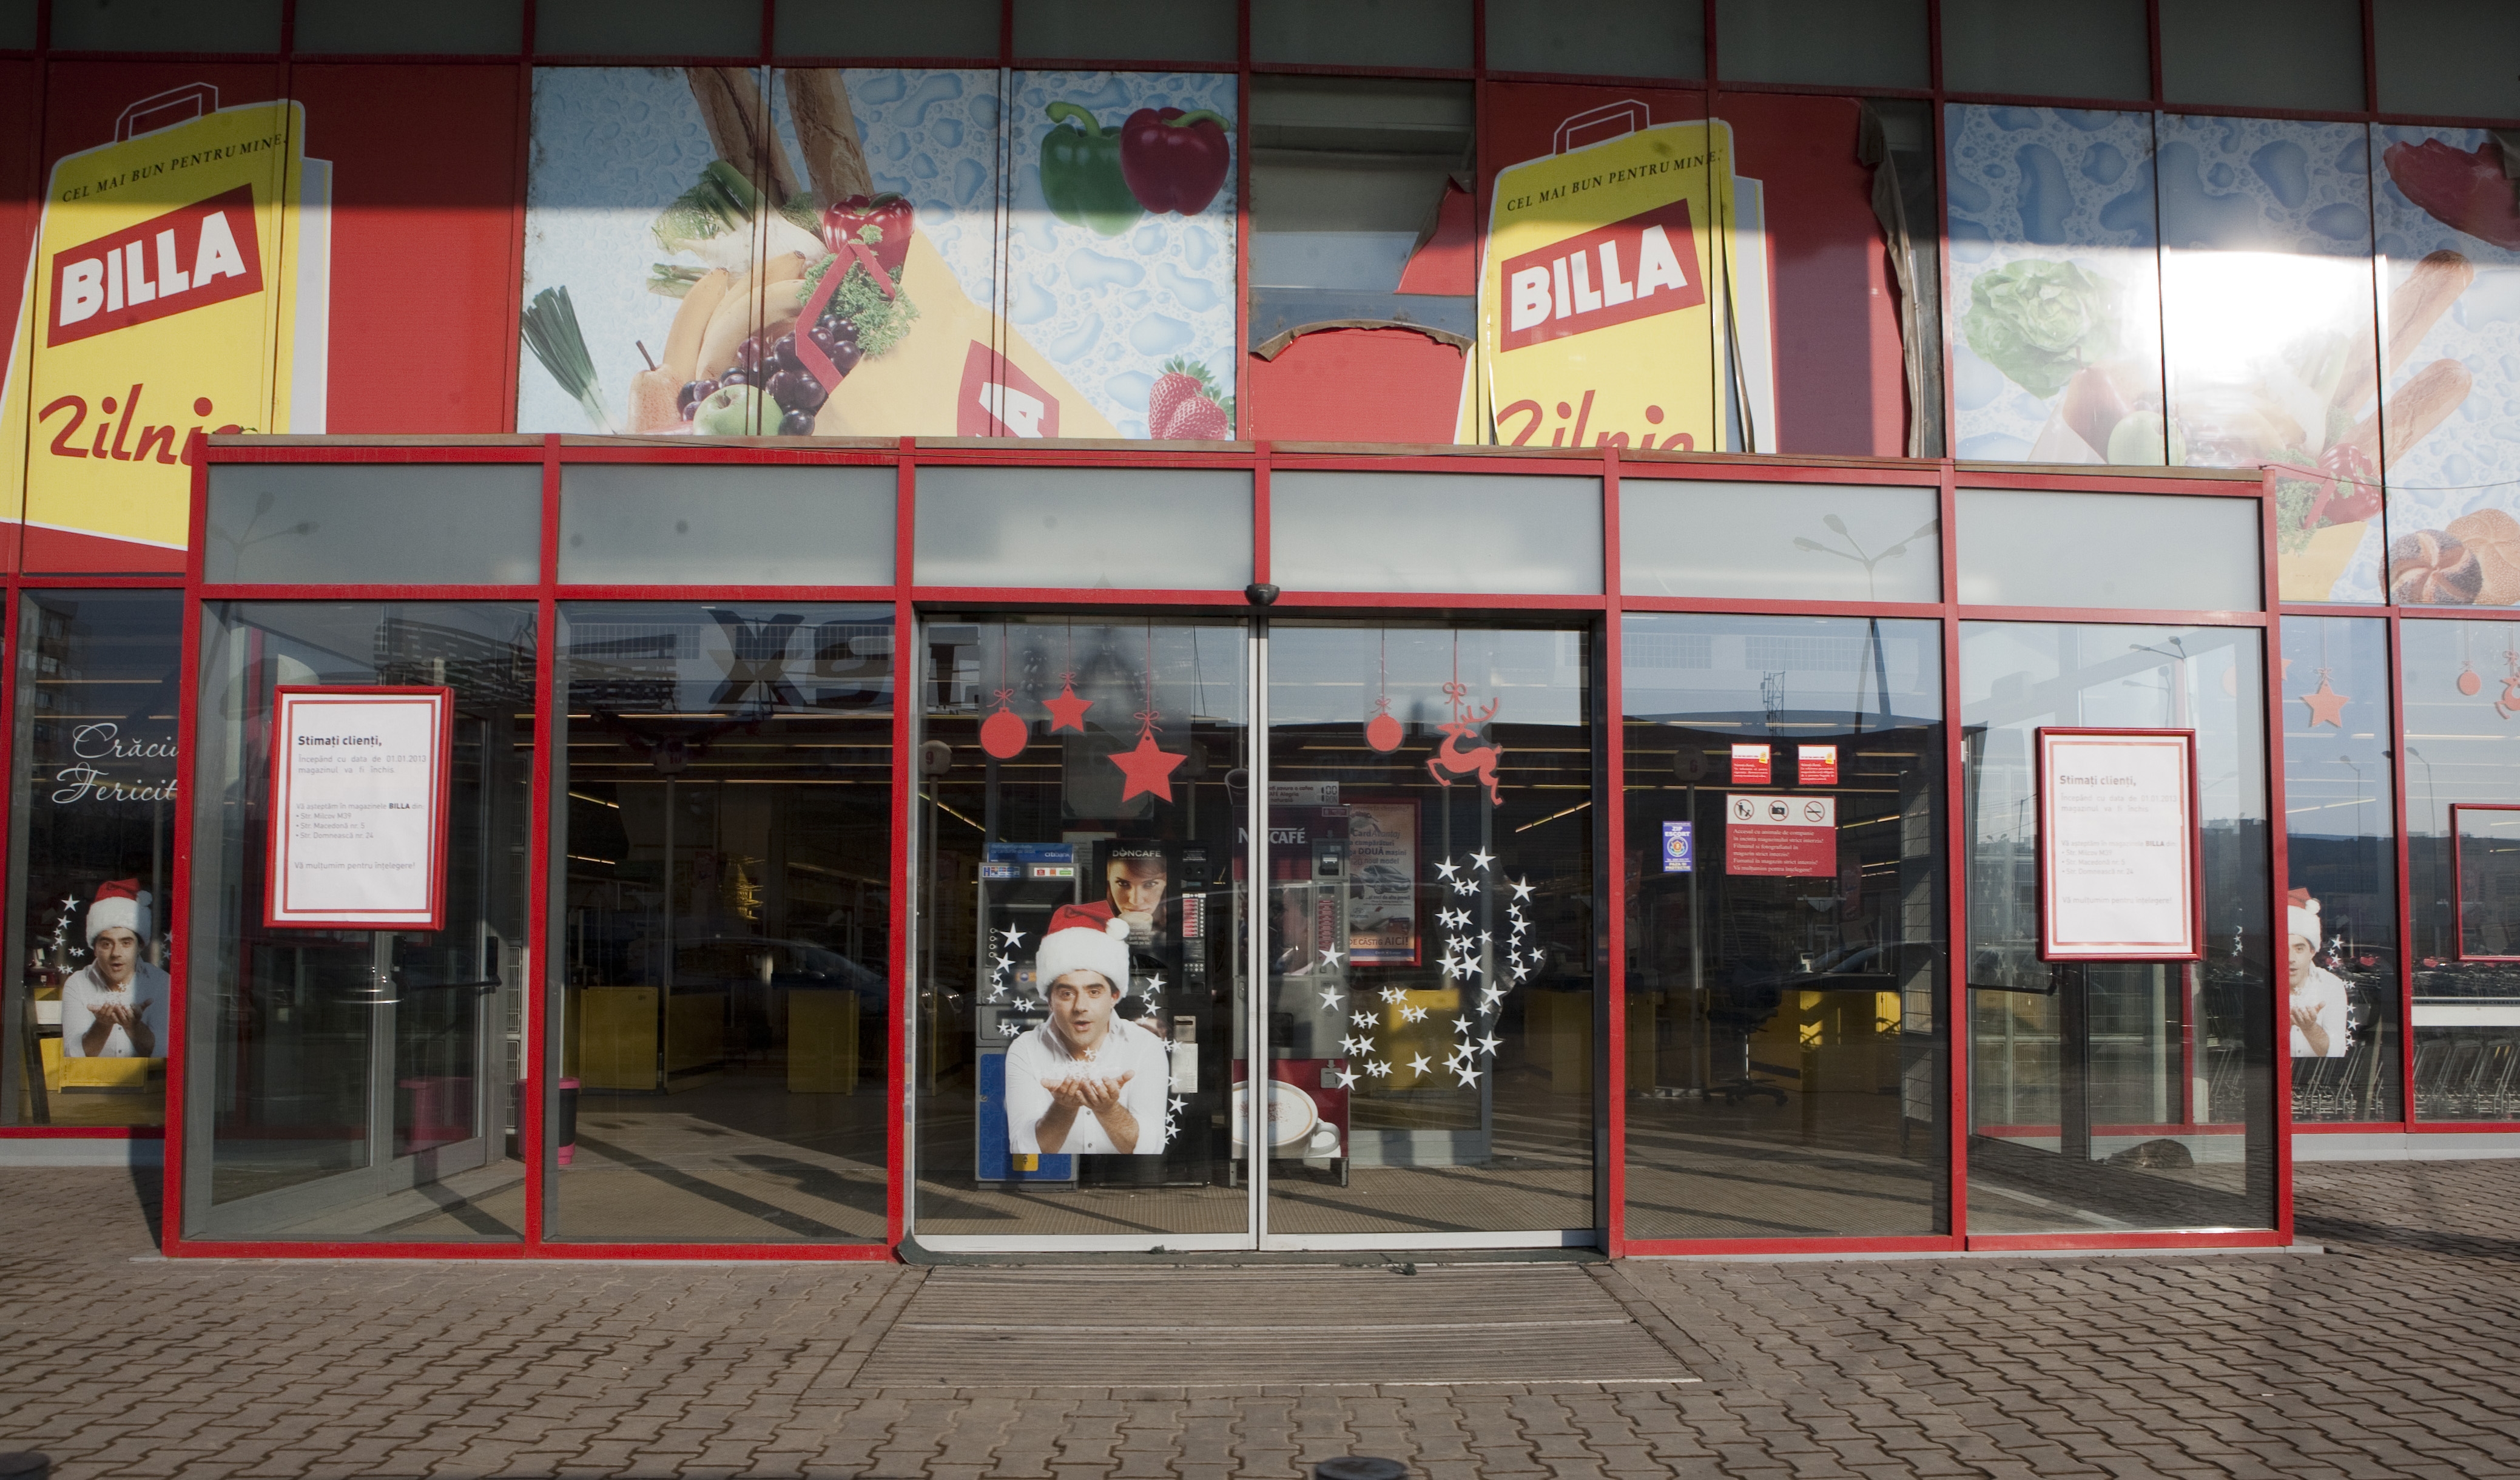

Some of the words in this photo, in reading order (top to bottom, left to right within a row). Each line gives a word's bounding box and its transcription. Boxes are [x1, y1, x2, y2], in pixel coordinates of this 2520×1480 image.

[62, 186, 90, 203] CEL
[96, 174, 126, 194] MAI
[131, 162, 166, 183] BUN
[170, 144, 237, 171] PENTRU
[1507, 195, 1534, 211] CEL
[1539, 185, 1567, 203] MAI
[1571, 175, 1603, 194] BUN
[1608, 161, 1671, 184] PENTRU
[59, 210, 247, 327] BILLA
[1511, 224, 1688, 333] BILLA
[298, 735, 340, 748] Stimați
[342, 735, 382, 748] clienți,
[298, 754, 333, 764] Începând
[925, 751, 934, 765] 9
[298, 766, 338, 775] magazinul
[2060, 775, 2098, 787] Stimați
[2100, 775, 2137, 788] clienți,
[348, 803, 387, 811] magazinele
[1238, 827, 1306, 844] NCAFÉ
[306, 862, 345, 871] mulțumim
[347, 862, 372, 871] pentru
[1384, 936, 1409, 946] AICI!
